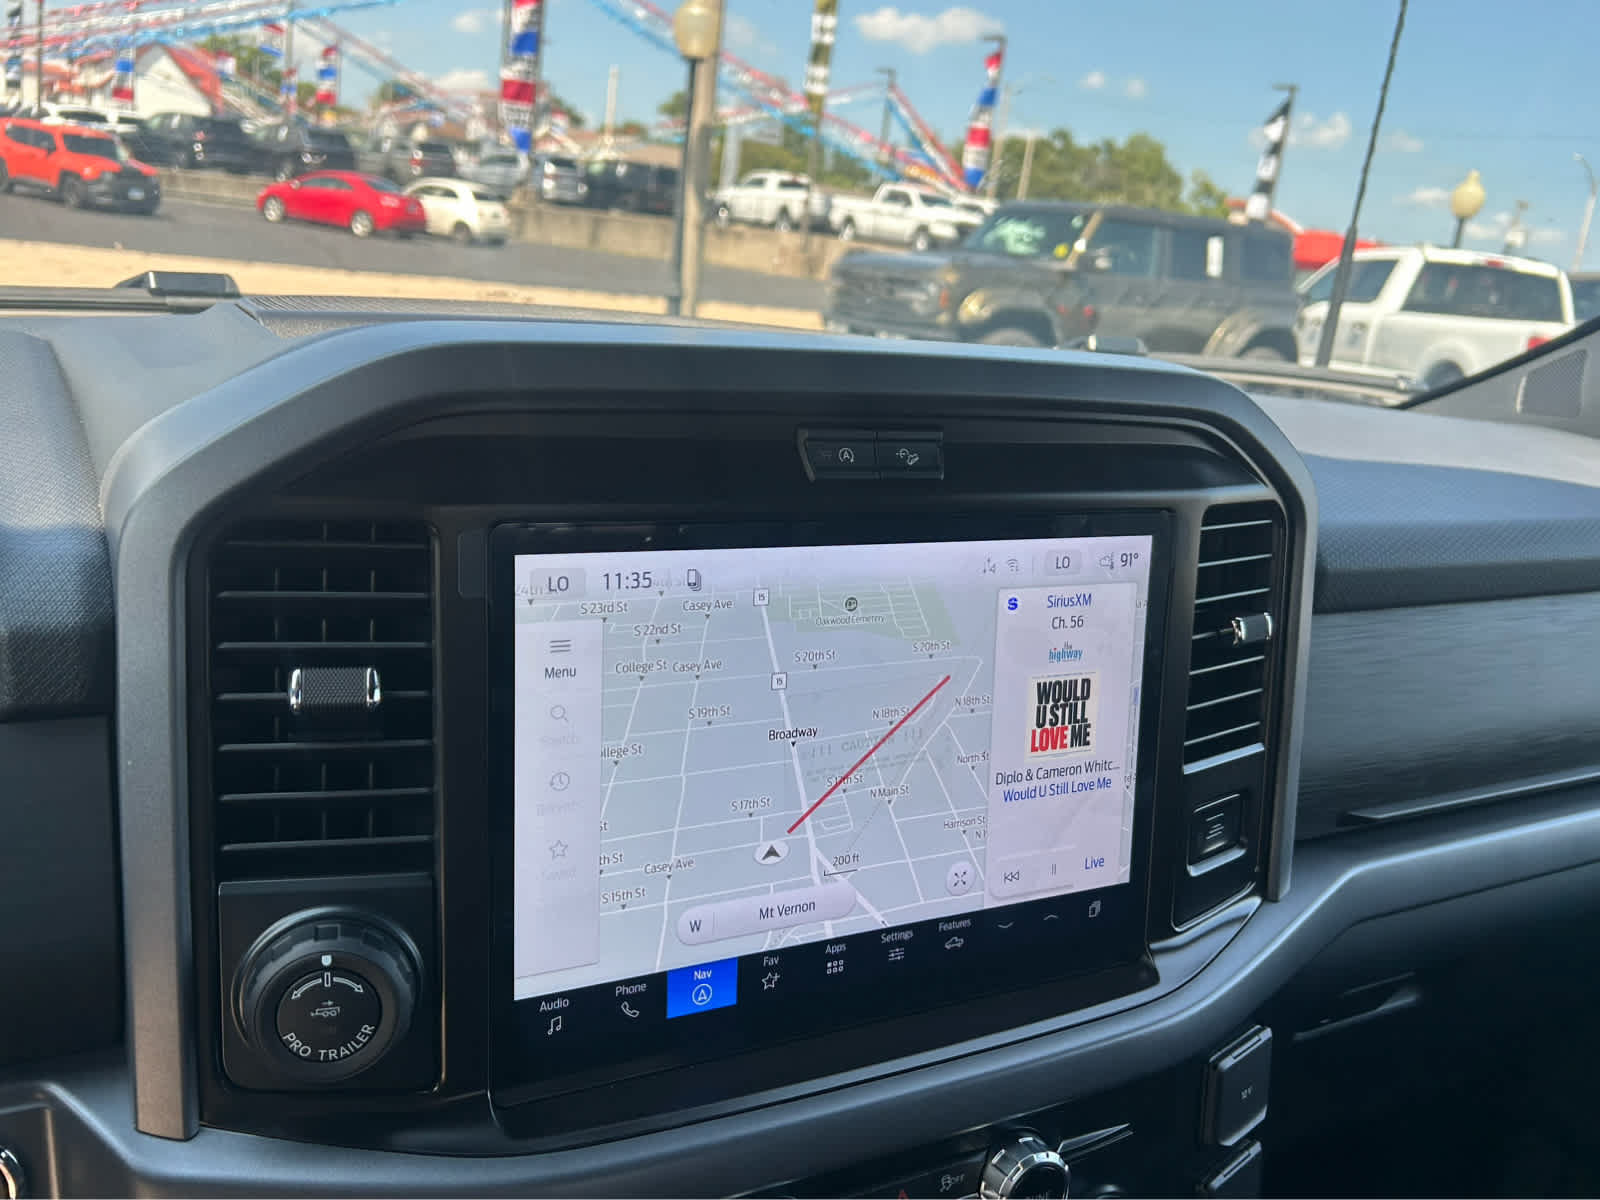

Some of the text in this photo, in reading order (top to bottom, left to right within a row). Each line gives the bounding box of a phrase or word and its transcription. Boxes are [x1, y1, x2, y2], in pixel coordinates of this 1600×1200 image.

[1055, 556, 1071, 570] LO
[548, 576, 569, 592] LO
[603, 570, 652, 591] 11:35
[580, 601, 628, 615] S 23rd St
[683, 600, 733, 613] Casey Ave
[1047, 593, 1092, 609] SiriusXM
[634, 623, 682, 636] S 22nd St
[1051, 616, 1084, 630] Ch. 56
[913, 641, 950, 653] S 20th St
[795, 649, 836, 662] S 20th St
[1049, 648, 1083, 664] highway
[544, 667, 577, 679] Menu
[615, 661, 667, 675] College St
[672, 660, 722, 674] Casey Ave
[1036, 678, 1091, 705] WOULD
[955, 695, 990, 706] N 18th St
[688, 706, 730, 719] S 19th St
[872, 710, 879, 719] N
[1035, 701, 1089, 728] U STILL
[768, 726, 818, 741] Broadway
[1030, 724, 1092, 752] LOVE ME
[600, 744, 642, 760] llege St
[957, 754, 979, 764] North
[826, 776, 833, 787] S
[854, 774, 863, 784] St
[995, 771, 1023, 787] Diplo
[1025, 768, 1033, 781] &
[1036, 763, 1082, 781] Cameron
[870, 784, 909, 798] N Main St
[1003, 785, 1037, 803] Would
[1038, 784, 1047, 798] U
[1049, 782, 1069, 797] Still
[1071, 779, 1095, 794] Love
[1097, 776, 1112, 790] Me
[731, 797, 771, 811] S 17th St
[943, 815, 986, 829] Harrison St
[612, 853, 623, 863] St
[833, 854, 860, 867] 200 ft
[1084, 856, 1105, 870] Live
[644, 859, 694, 875] Casey Ave
[601, 887, 646, 904] S 15th St
[690, 900, 816, 933] W Mt Vernon
[938, 917, 972, 932] Features
[881, 928, 914, 944] Settings
[825, 942, 847, 955] Apps
[763, 955, 780, 967] Fav
[693, 968, 712, 980] Nav
[615, 981, 647, 997] Phone
[539, 997, 569, 1013] Audio
[282, 1023, 375, 1061] PRO TRAILER
